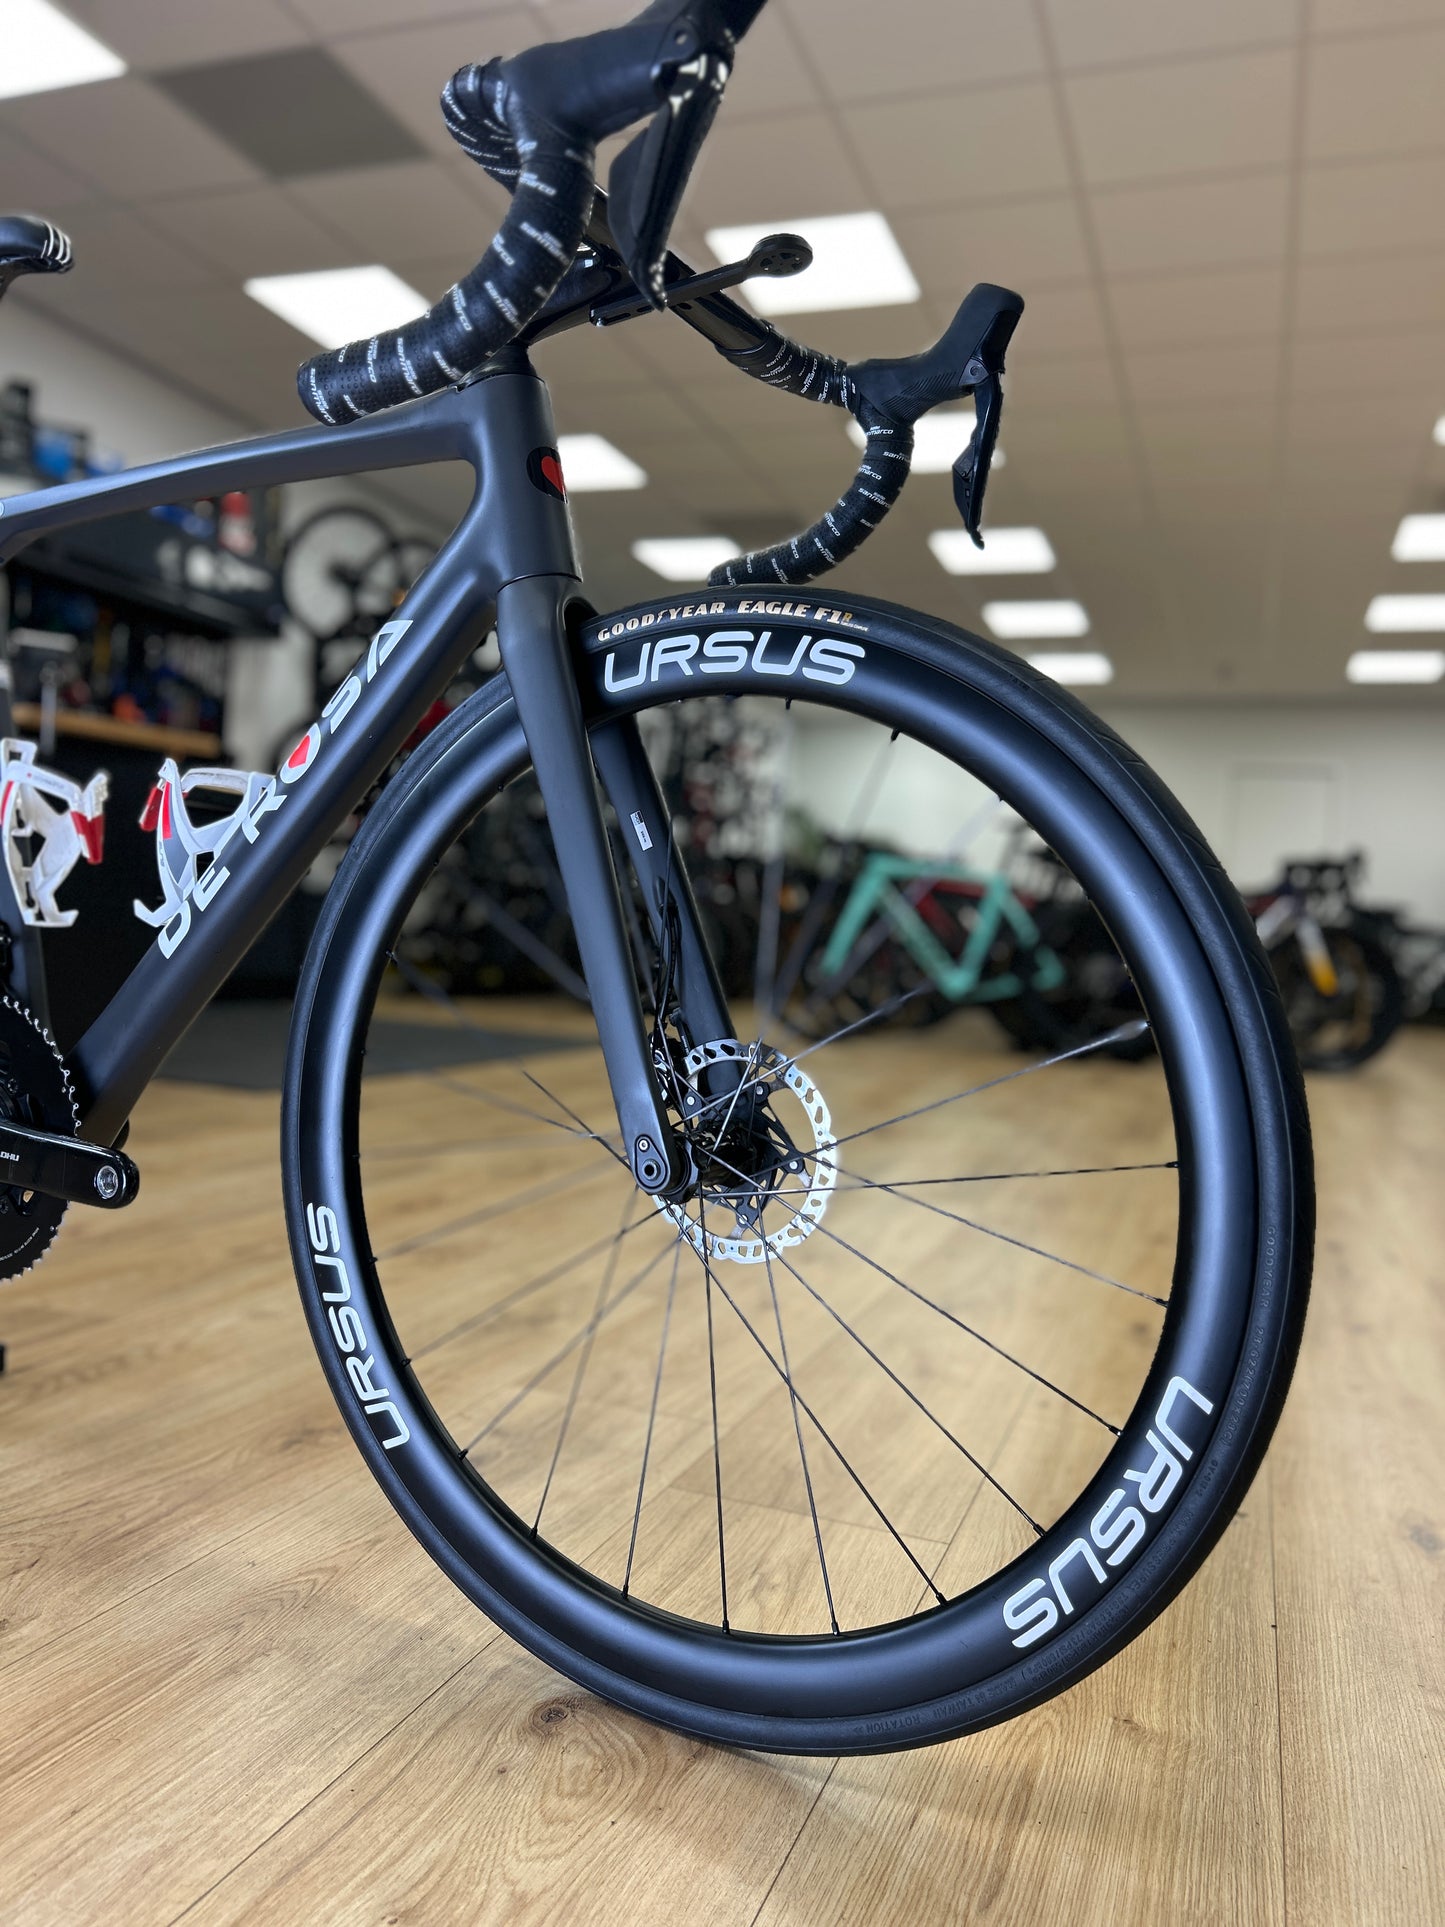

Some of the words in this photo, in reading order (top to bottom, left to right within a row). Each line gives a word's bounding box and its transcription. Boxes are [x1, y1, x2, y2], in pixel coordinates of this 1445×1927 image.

[598, 601, 726, 642] GOODYEAR
[736, 600, 811, 618] EAGLE
[604, 630, 866, 693] URSUS
[242, 619, 414, 844] ROSA
[1262, 1225, 1277, 1308] GOODYEAR
[306, 1202, 411, 1450] URSUS
[1002, 1375, 1214, 1648] URSUS
[866, 1715, 921, 1733] ROTATION
